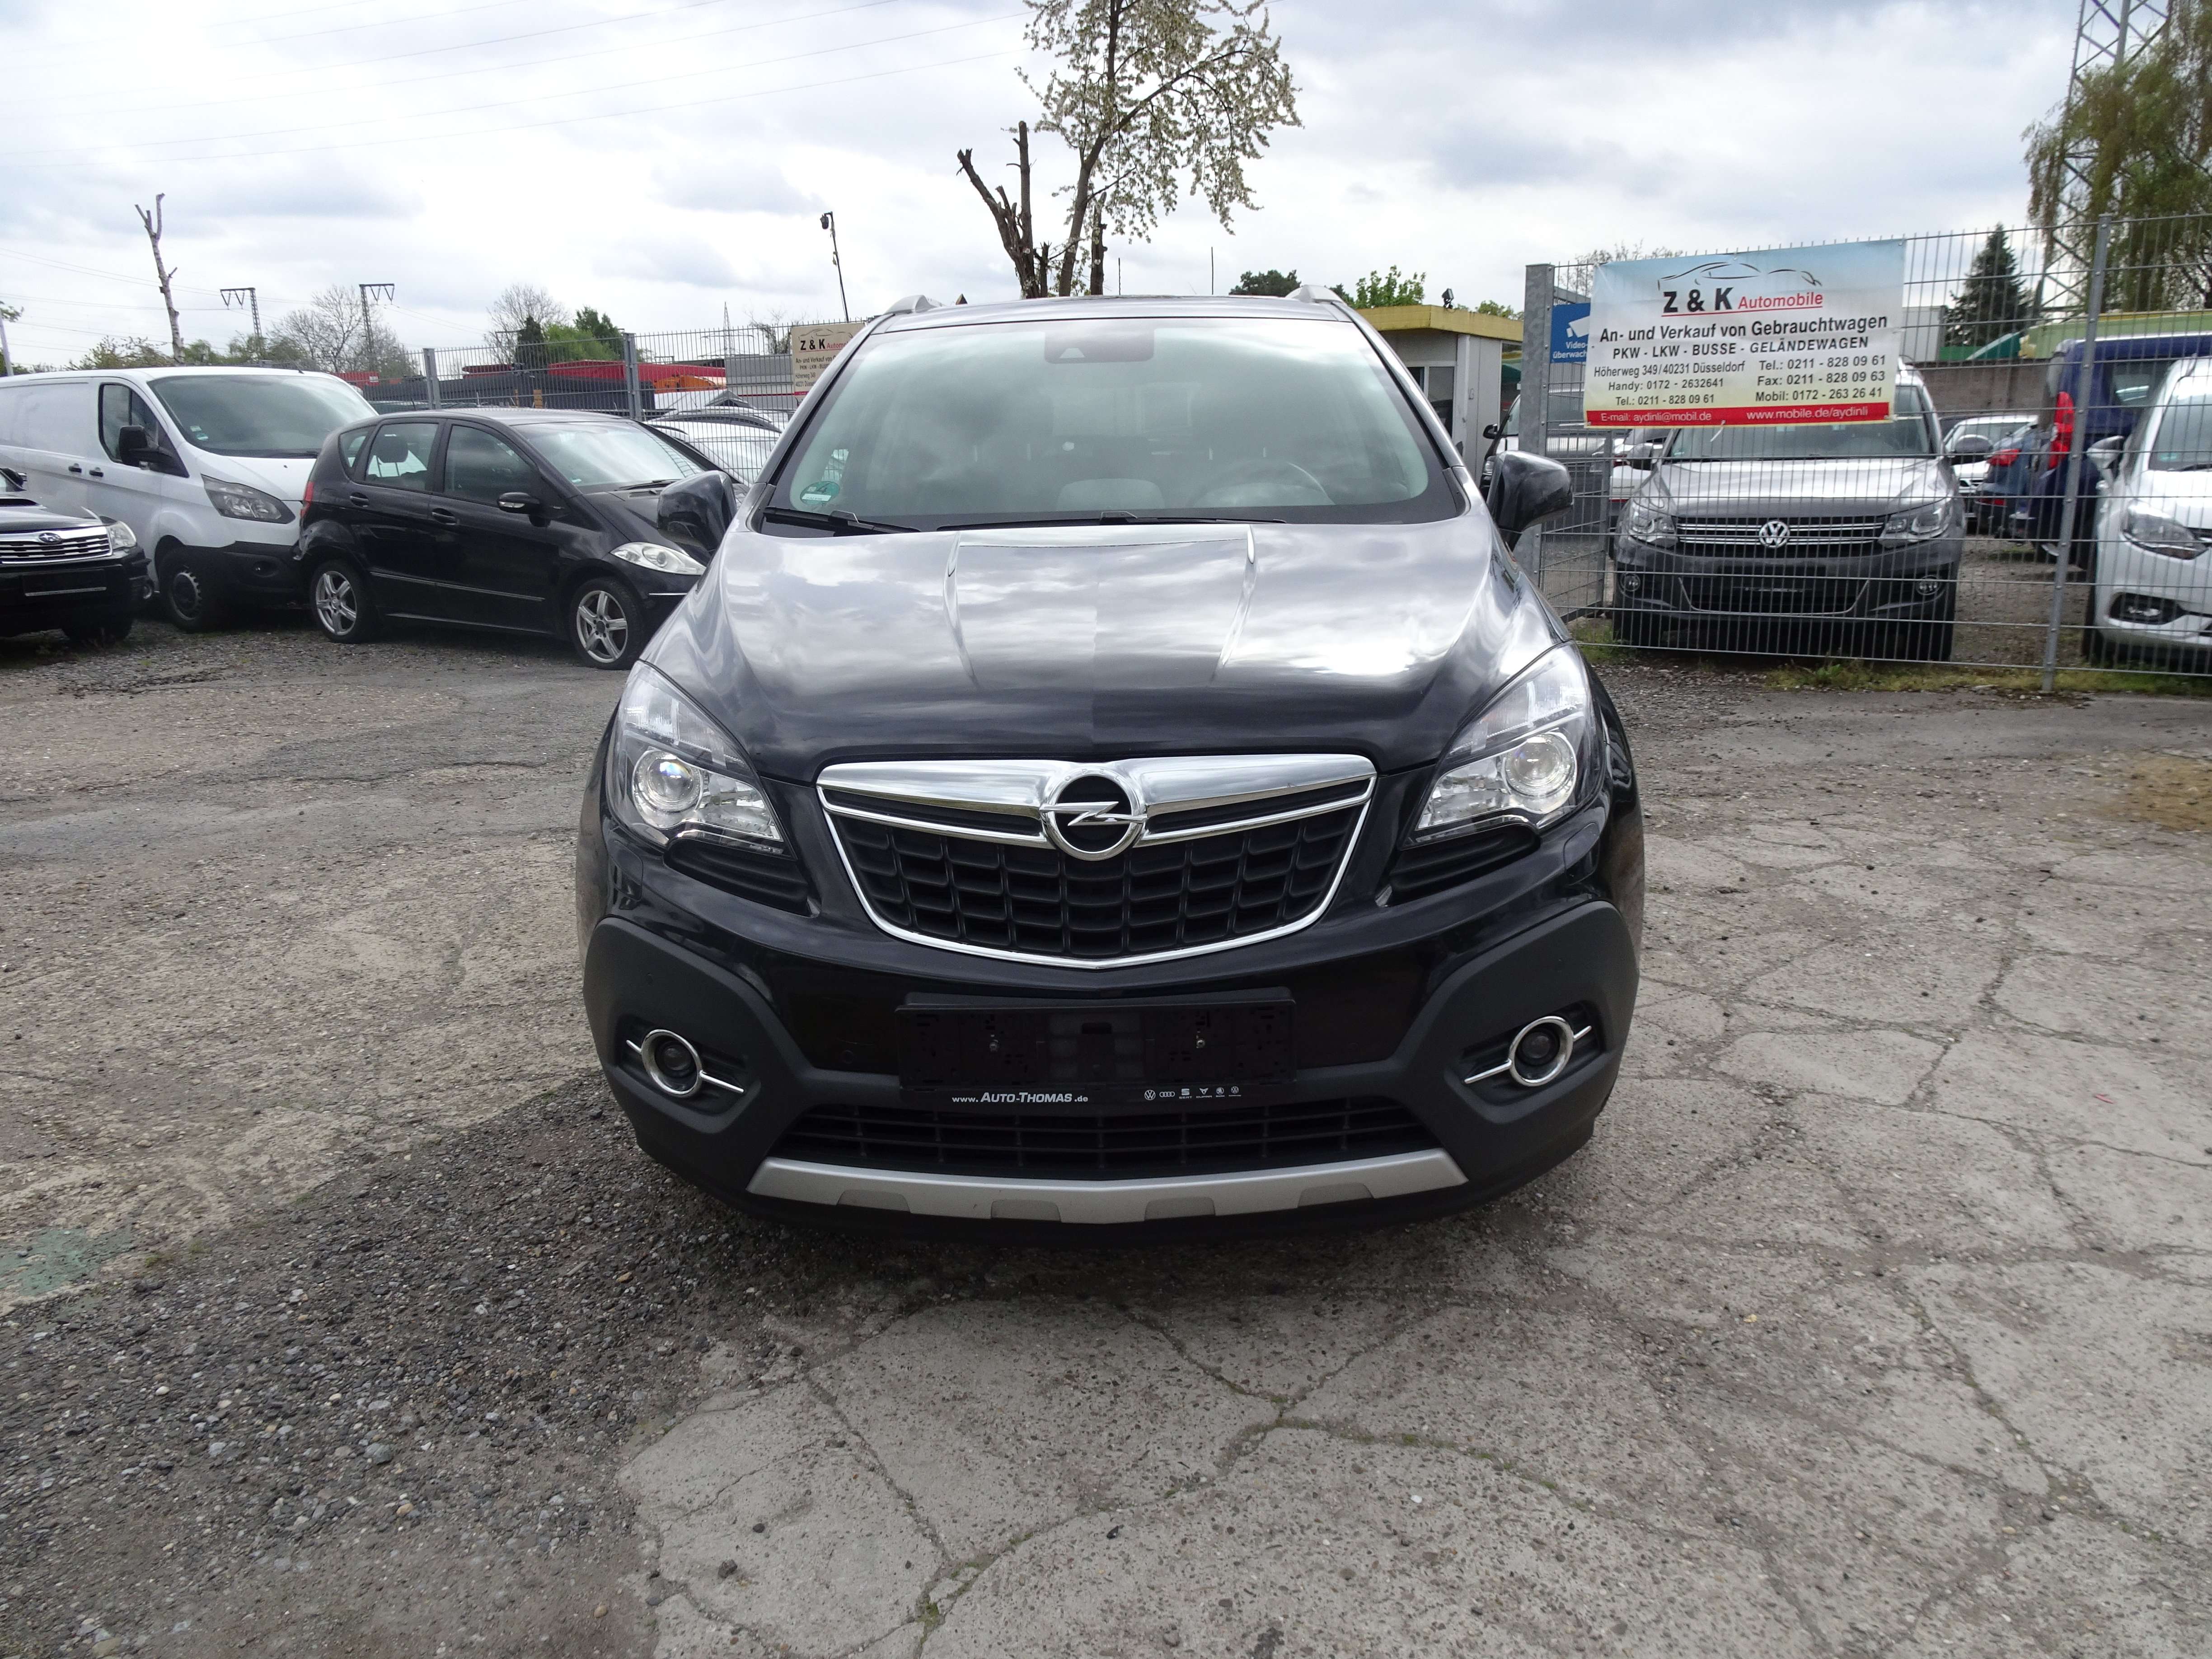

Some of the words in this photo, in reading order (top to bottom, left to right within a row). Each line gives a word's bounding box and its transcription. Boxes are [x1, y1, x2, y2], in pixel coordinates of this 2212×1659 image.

[1664, 291, 1678, 313] Z
[1687, 289, 1705, 312] &
[1715, 286, 1733, 310] K
[1738, 292, 1823, 309] Automobile
[1600, 328, 1623, 342] An-
[1629, 326, 1655, 340] und
[1660, 323, 1716, 339] Verkauf
[1721, 325, 1746, 337] von
[1751, 316, 1888, 336] Gebrauchtwagen
[801, 340, 806, 351] Z
[809, 339, 815, 350] &
[819, 338, 825, 349] K
[1613, 348, 1640, 359] PKW
[1652, 346, 1680, 357] LKW
[1692, 342, 1736, 356] BUSSE
[1750, 336, 1869, 353] GELÄNDEWAGEN
[1594, 365, 1639, 378] Höherweg
[1693, 361, 1745, 374] Düsseldorf
[1759, 360, 1783, 370] Tel.:
[1787, 358, 1814, 369] 0211
[1827, 357, 1849, 367] 828
[1853, 356, 1867, 366] 09
[1872, 355, 1885, 365] 61
[1609, 381, 1643, 393] Handy:
[1647, 380, 1670, 389] 0172
[1682, 378, 1724, 388] 2632641
[1757, 376, 1782, 386] Fax:
[1787, 374, 1813, 384] 0211
[1827, 373, 1847, 383] 828
[1852, 371, 1866, 382] 09
[1871, 370, 1885, 381] 63
[1616, 396, 1635, 406] Tel.:
[1638, 396, 1659, 405] 0211
[1669, 395, 1685, 404] 828
[1689, 394, 1701, 404] 09
[1703, 394, 1714, 403] 61
[1755, 391, 1788, 402] Mobil:
[1792, 390, 1818, 400] 0172
[1829, 389, 1849, 399] 263
[1852, 388, 1865, 398] 26
[1869, 387, 1882, 397] 41
[1601, 413, 1631, 422] E-mail:
[1633, 412, 1712, 422] aydinli@mobil.de
[1747, 407, 1868, 420] www.mobile.de/aydinli
